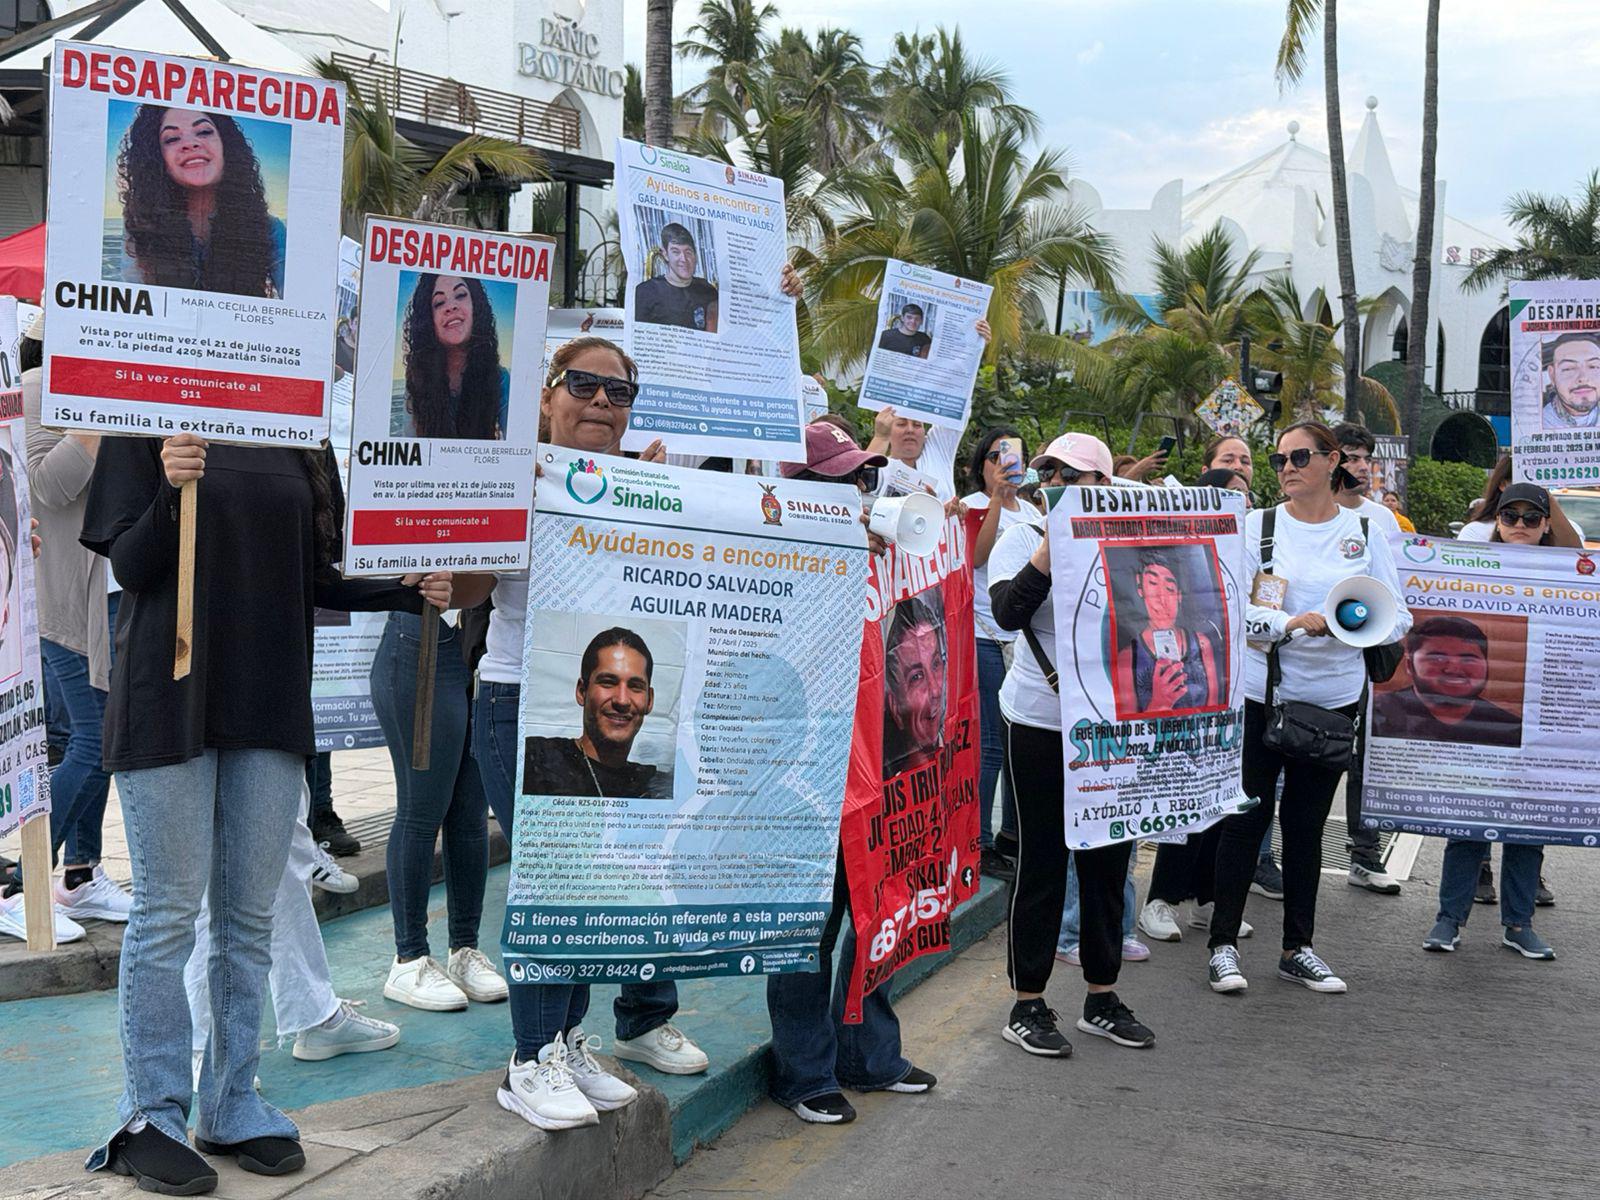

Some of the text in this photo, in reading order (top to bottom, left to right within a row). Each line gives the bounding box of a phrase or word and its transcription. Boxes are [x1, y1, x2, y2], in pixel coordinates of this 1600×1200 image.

[63, 49, 341, 126] DESAPARECIDA
[660, 156, 691, 174] Sinaloa
[647, 176, 761, 213] Ayúdanos encontrar
[638, 193, 775, 232] GAEL ALEJANDRO MARTINEZ VALDEZ
[370, 225, 550, 282] DESAPARECIDA
[55, 281, 154, 316] CHINA
[181, 297, 327, 321] MARIA CECILIA BERRELLEZA
[234, 314, 275, 326] FLORES
[79, 337, 94, 346] en
[97, 340, 114, 349] av.
[118, 339, 129, 350] la
[132, 342, 173, 355] piedad
[176, 347, 203, 359] 4205
[206, 349, 257, 362] Mazatlán
[80, 325, 301, 357] Vista por ultima vez el 21 de julio 2025
[131, 370, 143, 382] la
[147, 374, 169, 383] vez
[248, 381, 261, 393] al
[180, 389, 202, 400] 911
[54, 407, 315, 441] ¡Su familia la extraña mucho!
[358, 441, 422, 466] CHINA
[440, 446, 532, 456] MARIA CECILIA BERRELLEZA
[474, 456, 499, 465] FLORES
[611, 466, 640, 477] Comisión
[640, 470, 661, 479] Estatal
[613, 475, 643, 487] Búsqueda
[653, 480, 681, 490] Personas
[1535, 466, 1600, 480] 66932620
[373, 491, 383, 499] en
[384, 491, 396, 499] av.
[398, 490, 406, 499] la
[407, 491, 434, 500] piedad
[435, 492, 453, 500] 4205
[455, 490, 488, 499] Mazatlán
[374, 480, 394, 489] Vista
[395, 482, 409, 490] por
[410, 480, 435, 489] ultima
[451, 480, 459, 489] el
[470, 480, 480, 489] de
[480, 480, 497, 490] julio
[499, 482, 515, 490] 2025
[612, 486, 683, 513] Sinaloa
[787, 500, 851, 517] SINALOA
[1080, 487, 1223, 513] DESAPARECIDO
[405, 517, 414, 526] la
[416, 518, 431, 526] vez
[481, 517, 489, 525] al
[788, 512, 818, 521] GOBIERNO
[1103, 519, 1144, 536] EDUARDO
[1194, 517, 1237, 534] CAMACHO
[437, 530, 451, 538] 911
[568, 525, 847, 576] Ayúdanos a encontrar a
[354, 553, 521, 570] ¡Su familia la extraña mucho!
[1441, 553, 1501, 570] Sinaloa
[623, 566, 794, 598] RICARDO SALVADOR
[1406, 575, 1535, 597] Ayúdanos a
[630, 596, 783, 624] AGUILAR MADERA
[1405, 594, 1600, 619] OSCAR DAVID ARAMBUR
[1076, 723, 1132, 741] FUE PRIVADO
[1366, 789, 1580, 814] Si tienes información referente a
[1366, 799, 1400, 811] llama
[1404, 804, 1412, 812] o
[1492, 810, 1507, 820] Tu
[1511, 811, 1548, 824] ayuda
[1552, 816, 1566, 824] es
[1569, 816, 1593, 827] muy
[1424, 824, 1444, 834] 327
[1445, 826, 1471, 837] 8424
[511, 912, 526, 926] Si
[532, 912, 578, 926] tienes
[585, 912, 667, 926] información
[672, 911, 727, 925] referente
[733, 912, 741, 923] a
[745, 911, 772, 923] esta
[507, 926, 821, 947] llama o escribenos. Tu ayuda es muy importante.
[542, 963, 638, 979] (669) 327 8424
